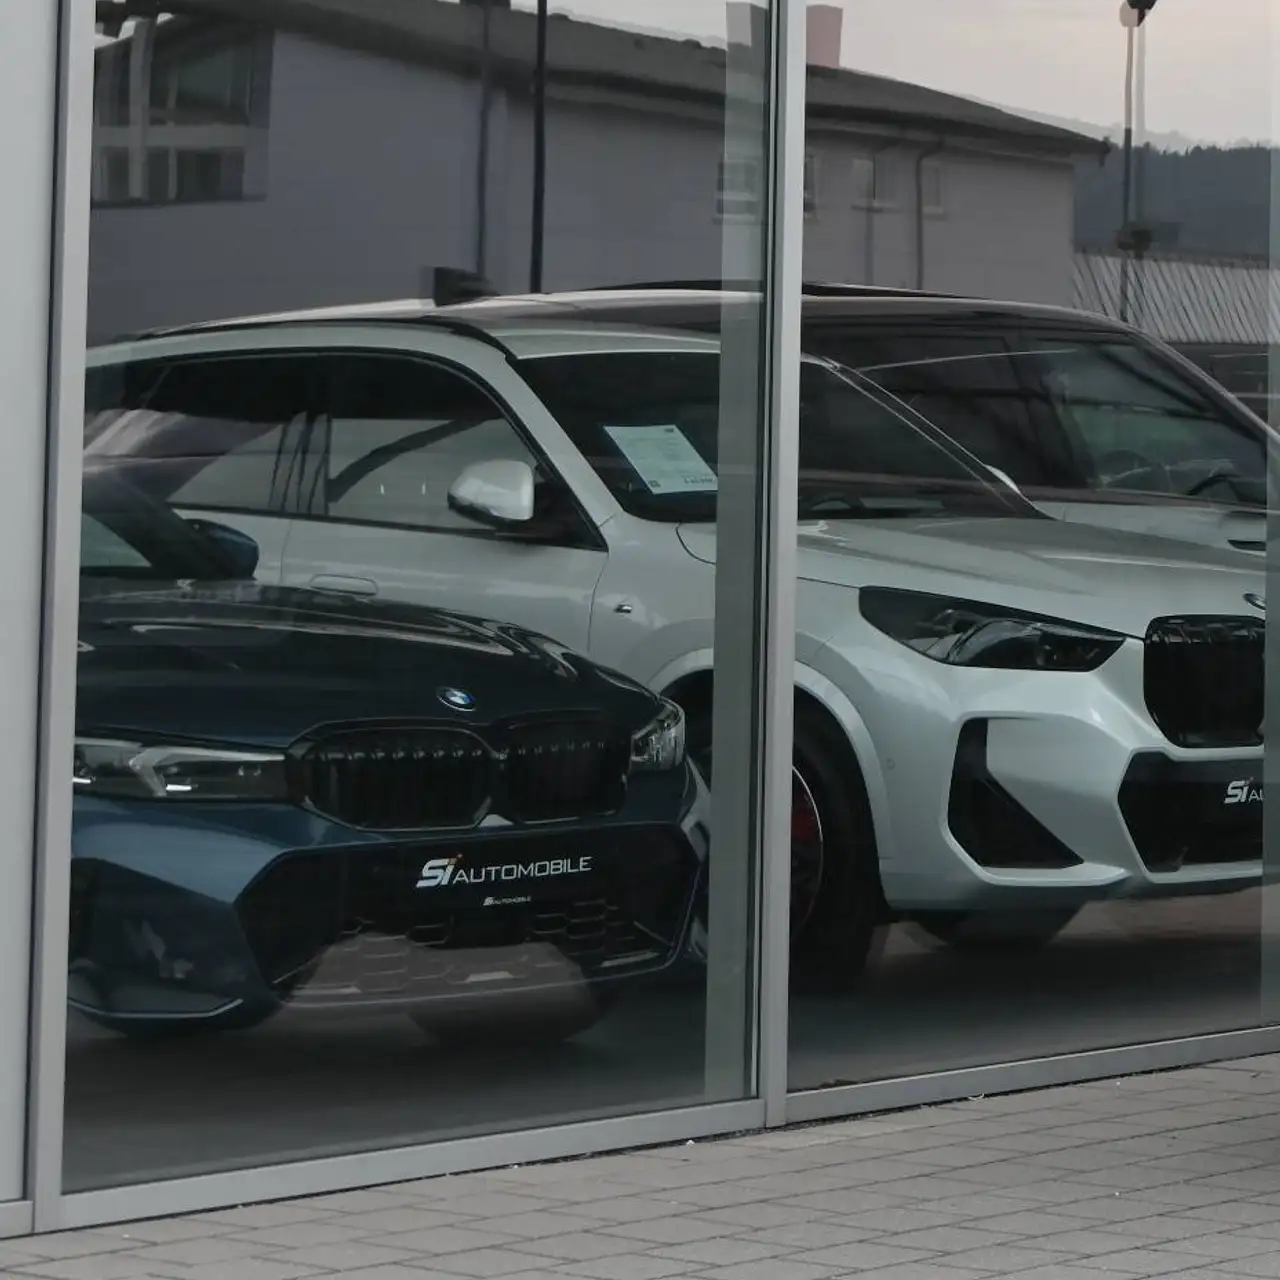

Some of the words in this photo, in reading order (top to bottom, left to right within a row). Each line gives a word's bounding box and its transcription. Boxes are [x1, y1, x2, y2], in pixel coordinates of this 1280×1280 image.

[1224, 776, 1254, 804] Si
[416, 854, 463, 888] Si
[453, 856, 593, 885] AUTOMOBILE
